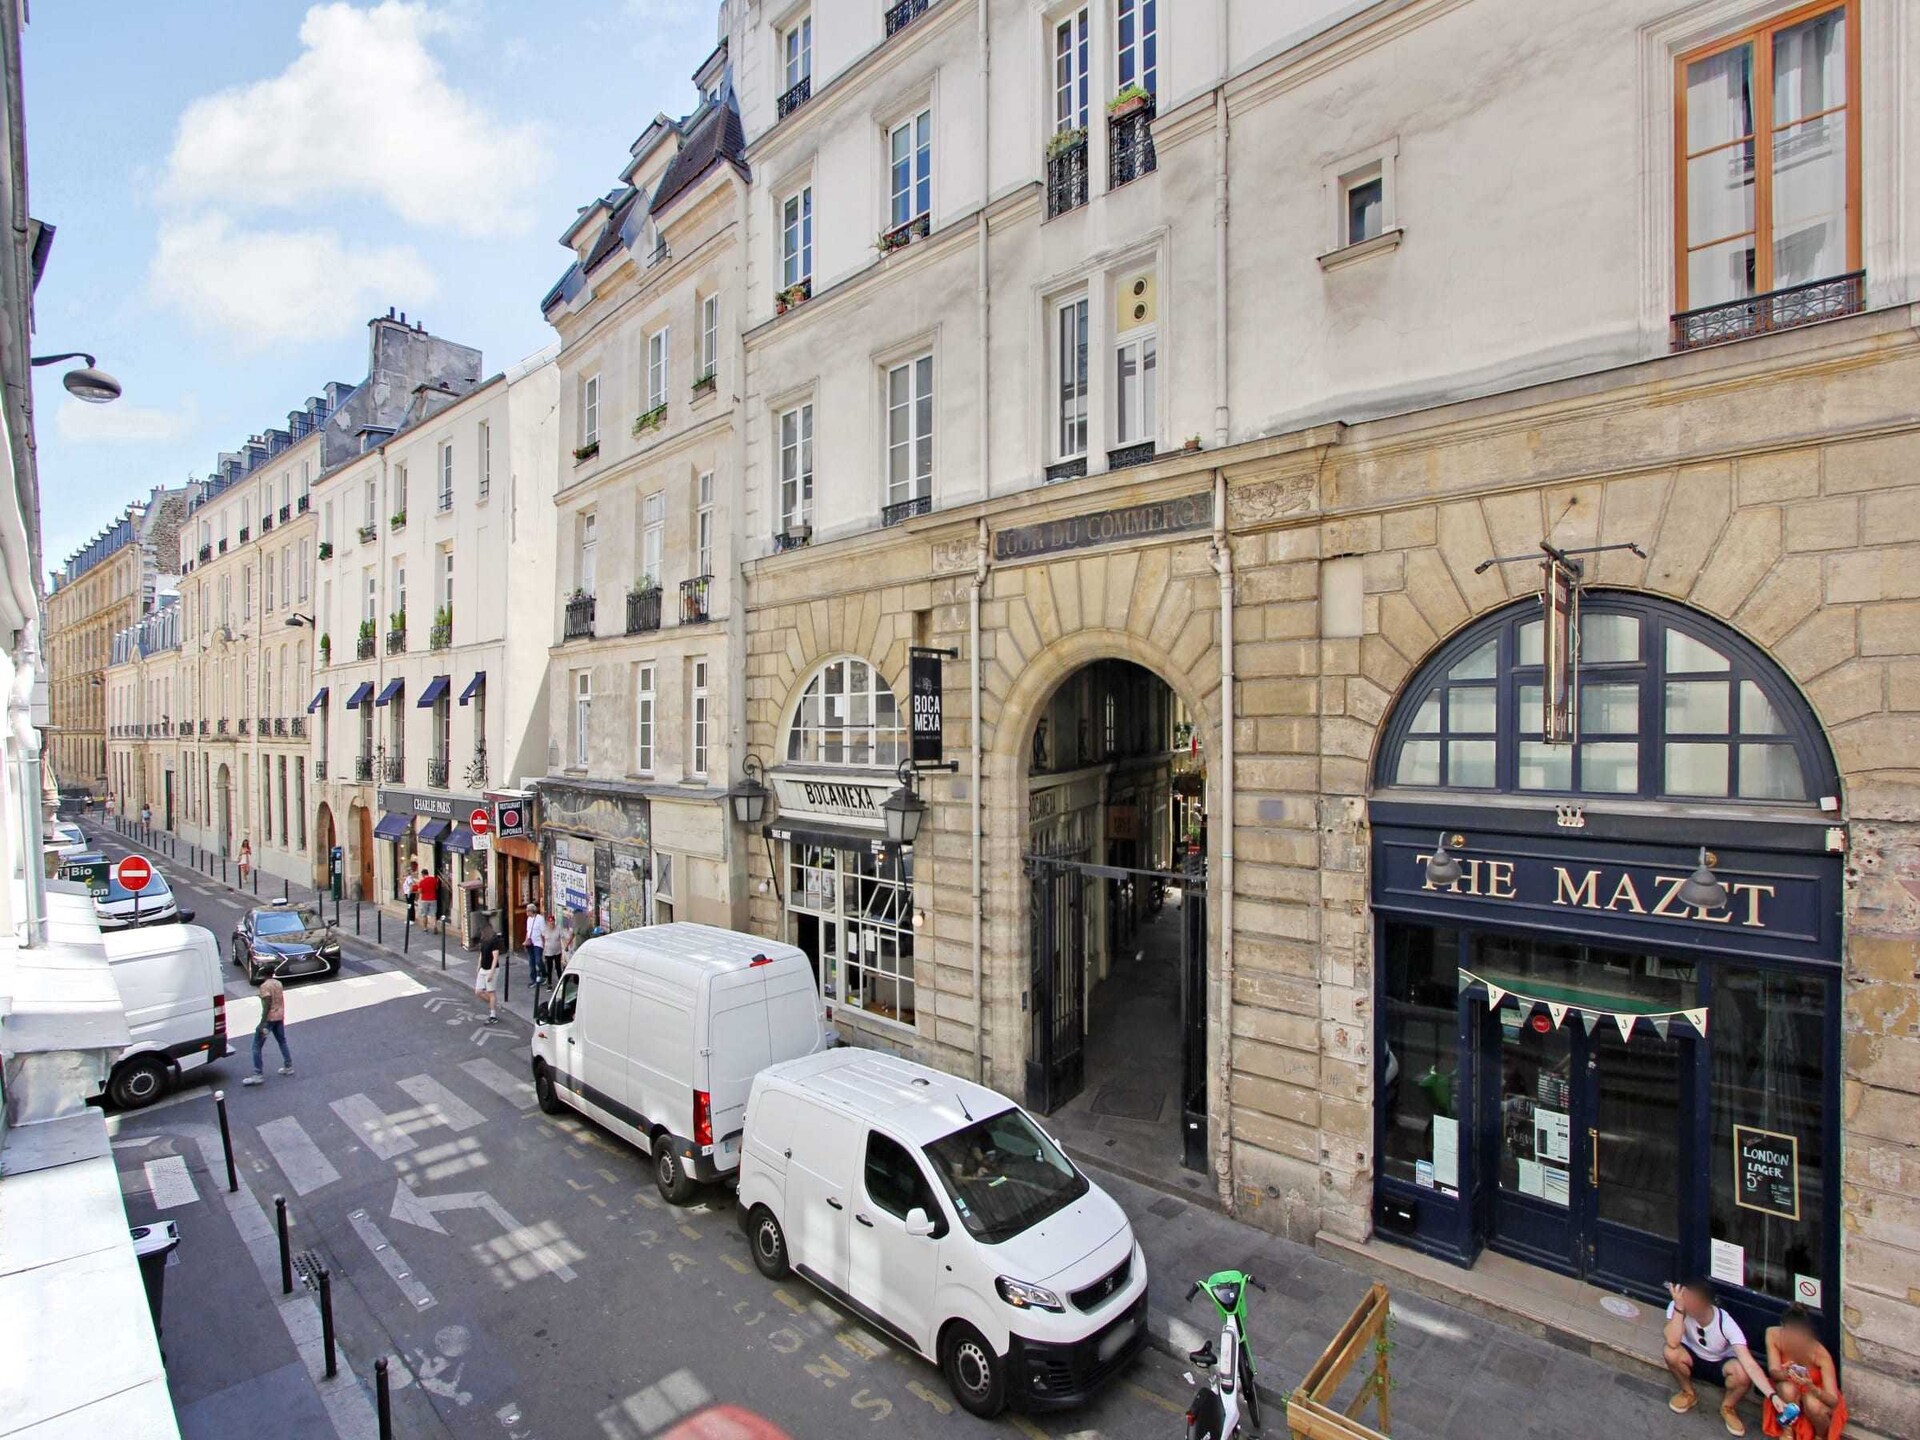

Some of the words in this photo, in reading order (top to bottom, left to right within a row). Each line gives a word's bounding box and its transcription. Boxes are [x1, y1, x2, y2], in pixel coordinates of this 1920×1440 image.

[1051, 521, 1079, 546] DU
[914, 695, 940, 713] BOCA
[914, 713, 940, 731] MEXA
[804, 783, 875, 810] BOCAMEXA
[413, 798, 436, 812] CHARLIE
[436, 801, 451, 814] PARIS
[499, 802, 521, 810] RESTAURANT
[501, 827, 522, 836] JAPONAIS
[71, 867, 92, 876] Bio
[1743, 1146, 1789, 1166] LONDON
[1748, 1162, 1783, 1179] LAGER
